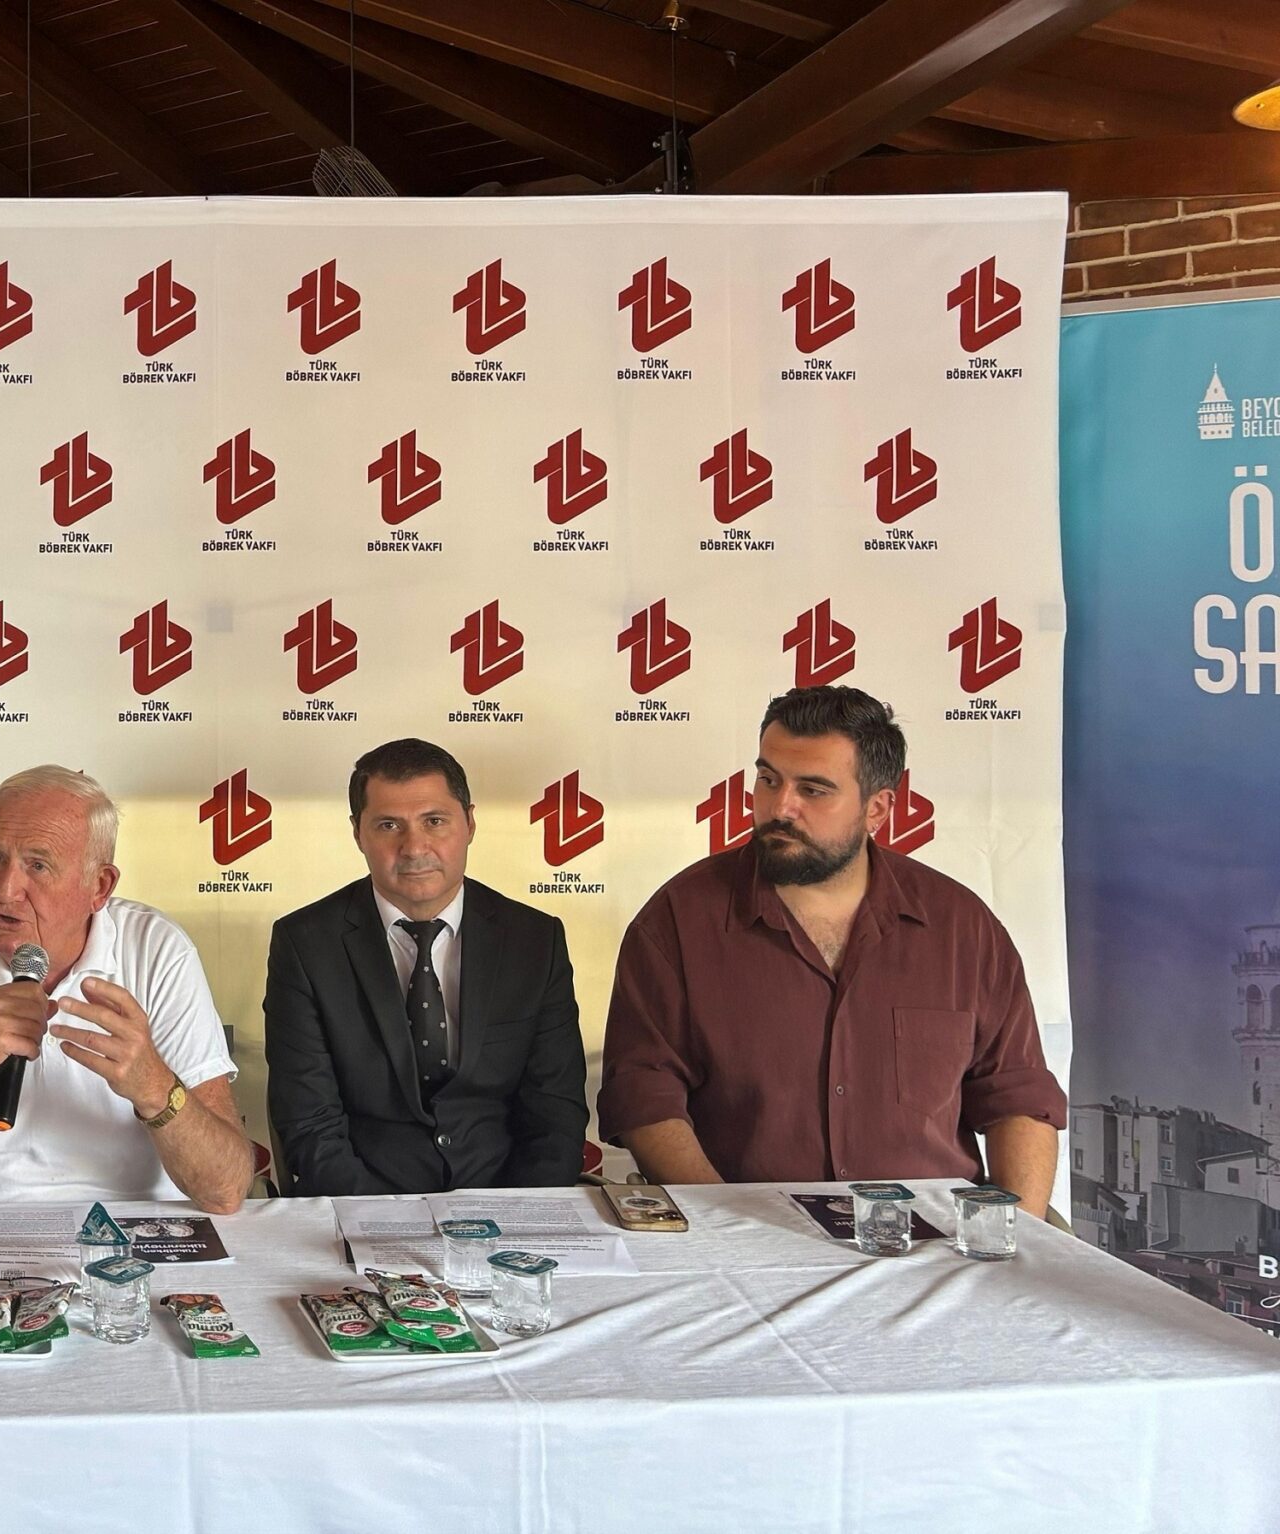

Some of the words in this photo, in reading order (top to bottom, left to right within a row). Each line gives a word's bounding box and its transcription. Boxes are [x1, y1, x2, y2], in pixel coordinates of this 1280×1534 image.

[146, 361, 173, 372] TÜRK
[309, 360, 337, 371] TÜRK
[475, 359, 502, 370] TÜRK
[641, 357, 668, 368] TÜRK
[804, 358, 832, 369] TÜRK
[969, 357, 997, 368] TÜRK
[123, 371, 165, 383] BÖBREK
[166, 373, 197, 383] VAKFI
[286, 370, 328, 381] BÖBREK
[330, 371, 361, 381] VAKFI
[451, 369, 494, 381] BÖBREK
[496, 371, 526, 381] VAKFI
[617, 367, 660, 379] BÖBREK
[662, 369, 692, 379] VAKFI
[782, 368, 824, 380] BÖBREK
[825, 370, 856, 380] VAKFI
[947, 367, 988, 379] BÖBREK
[990, 368, 1023, 378] VAKFI
[3, 374, 33, 384] VAKFI
[62, 531, 89, 542] TÜRK
[225, 529, 252, 540] TÜRK
[391, 530, 418, 541] TÜRK
[557, 529, 584, 540] TÜRK
[723, 528, 750, 539] TÜRK
[886, 528, 913, 539] TÜRK
[39, 541, 81, 553] BÖBREK
[83, 543, 113, 553] VAKFI
[203, 539, 245, 551] BÖBREK
[246, 541, 276, 551] VAKFI
[368, 540, 410, 551] BÖBREK
[412, 541, 443, 551] VAKFI
[534, 539, 577, 551] BÖBREK
[578, 541, 609, 551] VAKFI
[700, 538, 743, 550] BÖBREK
[744, 540, 775, 550] VAKFI
[865, 538, 907, 550] BÖBREK
[908, 540, 938, 550] VAKFI
[142, 700, 169, 711] TÜRK
[306, 699, 334, 710] TÜRK
[472, 700, 500, 711] TÜRK
[639, 699, 667, 710] TÜRK
[969, 698, 997, 709] TÜRK
[0, 712, 29, 722] VAKFI
[119, 710, 161, 722] BÖBREK
[162, 712, 193, 722] VAKFI
[283, 709, 325, 721] BÖBREK
[327, 711, 358, 721] VAKFI
[449, 710, 491, 722] BÖBREK
[493, 712, 524, 722] VAKFI
[616, 709, 658, 721] BÖBREK
[660, 711, 690, 721] VAKFI
[946, 708, 989, 720] BÖBREK
[990, 710, 1021, 720] VAKFI
[221, 870, 249, 881] TÜRK
[553, 871, 581, 882] TÜRK
[199, 880, 241, 892] BÖBREK
[242, 882, 273, 892] VAKFI
[530, 881, 572, 893] BÖBREK
[574, 883, 606, 893] VAKFI
[187, 1321, 234, 1333] Karma
